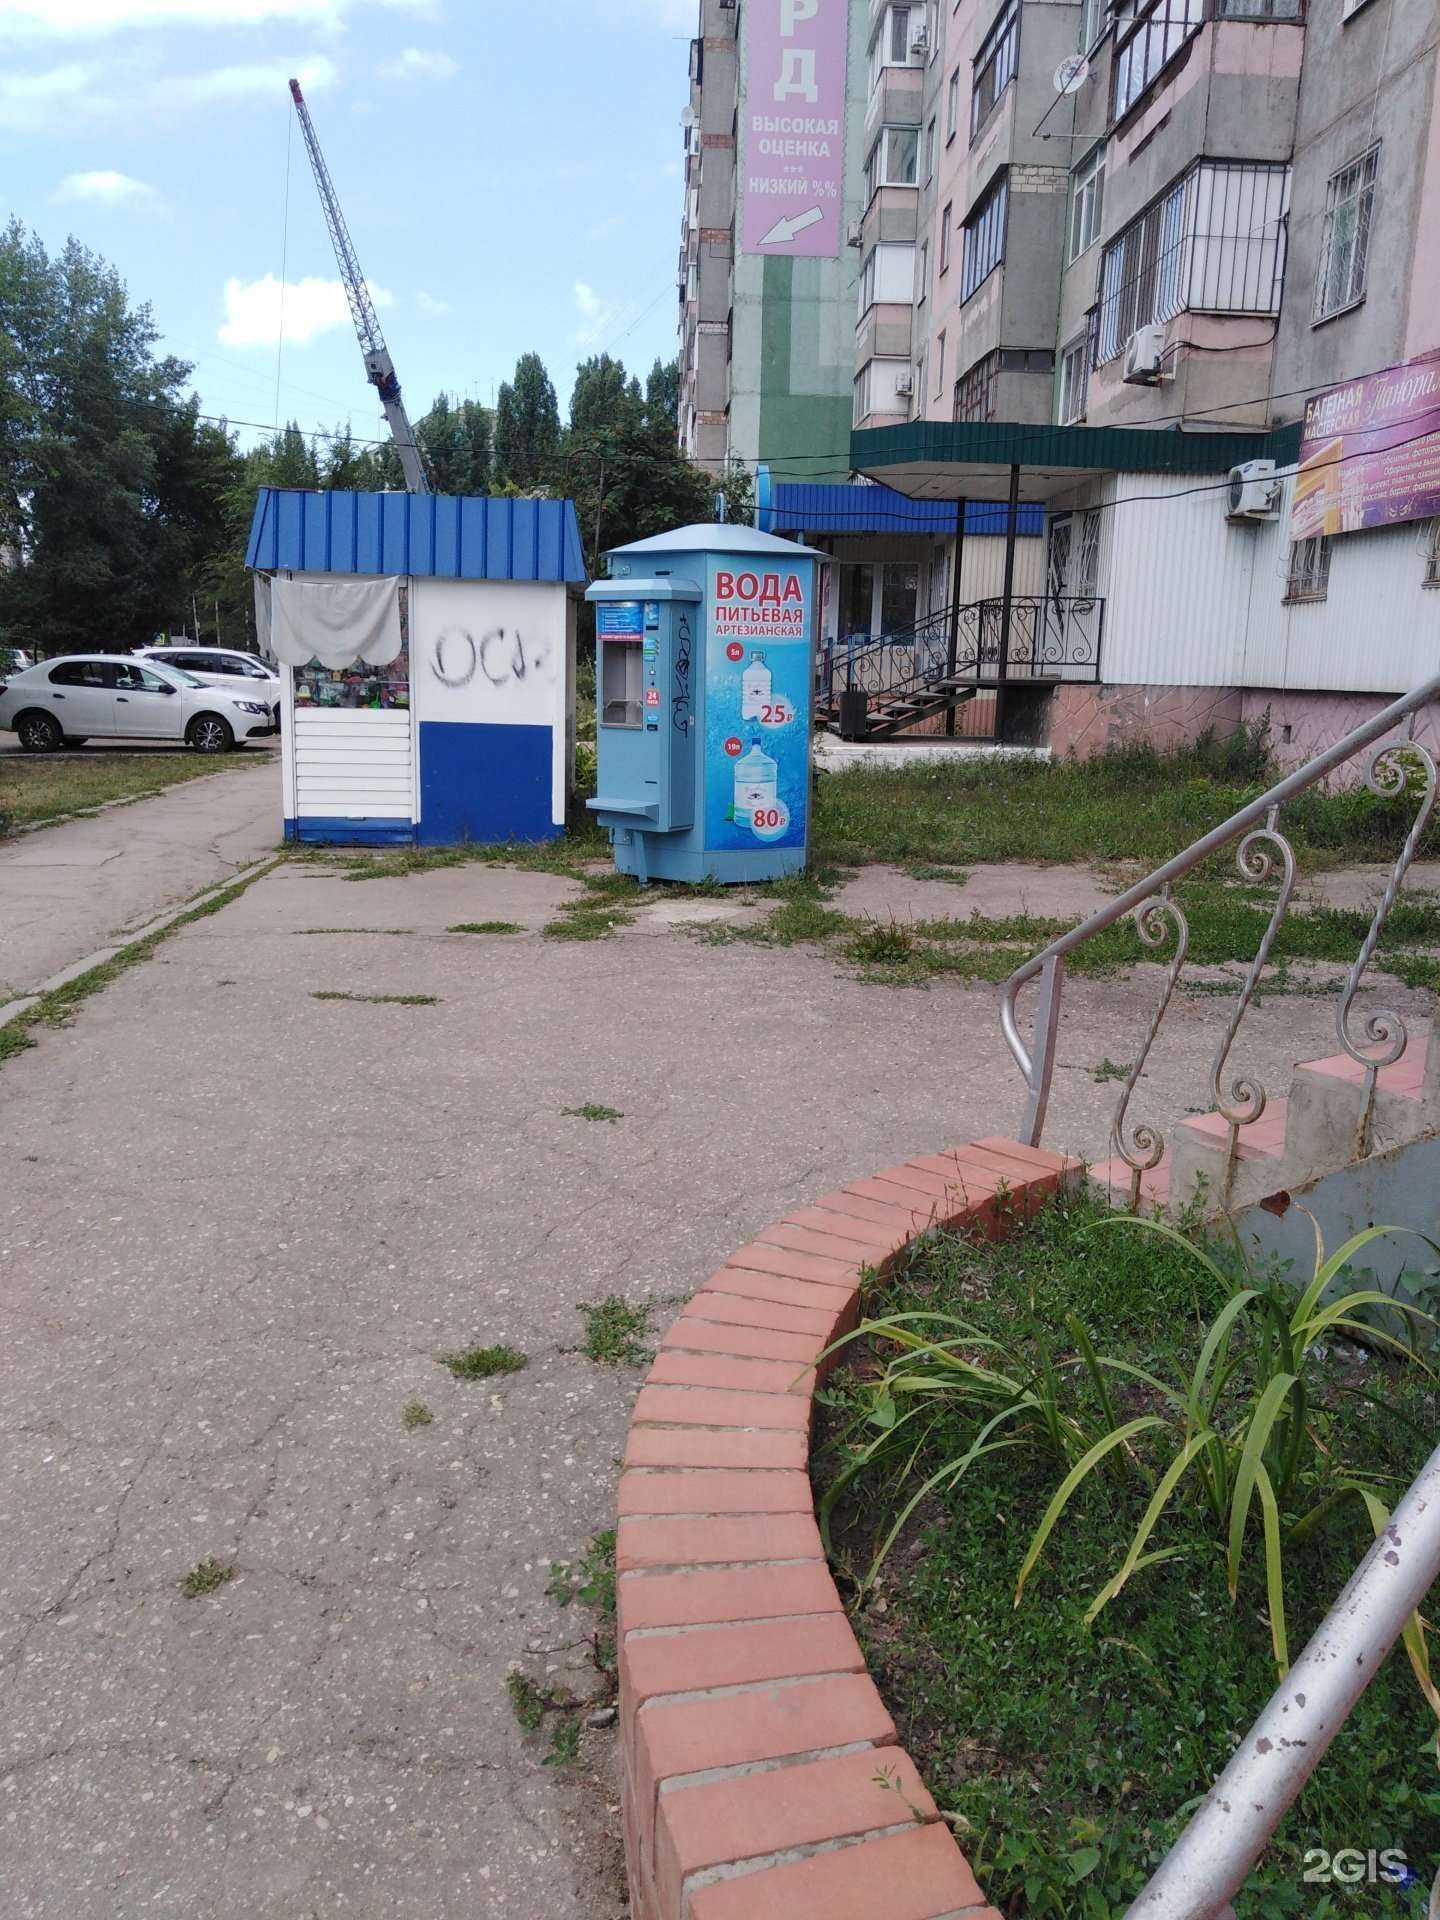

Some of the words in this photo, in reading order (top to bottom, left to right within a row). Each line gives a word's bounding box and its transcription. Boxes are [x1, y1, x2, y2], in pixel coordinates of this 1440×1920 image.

[751, 116, 839, 135] ВЫСОКАЯ
[758, 138, 831, 159] ОЦЕНКА
[749, 176, 808, 195] НИЗКИЙ
[812, 180, 837, 198] %%
[1306, 383, 1364, 423] БАГЕТНАЯ
[1303, 409, 1361, 441] МАСТЕРСКАЯ
[716, 572, 803, 607] ВОДА
[716, 606, 803, 624] ПИТЬЕВАЯ
[715, 624, 803, 637] АРТЕЗИАНСКАЯ
